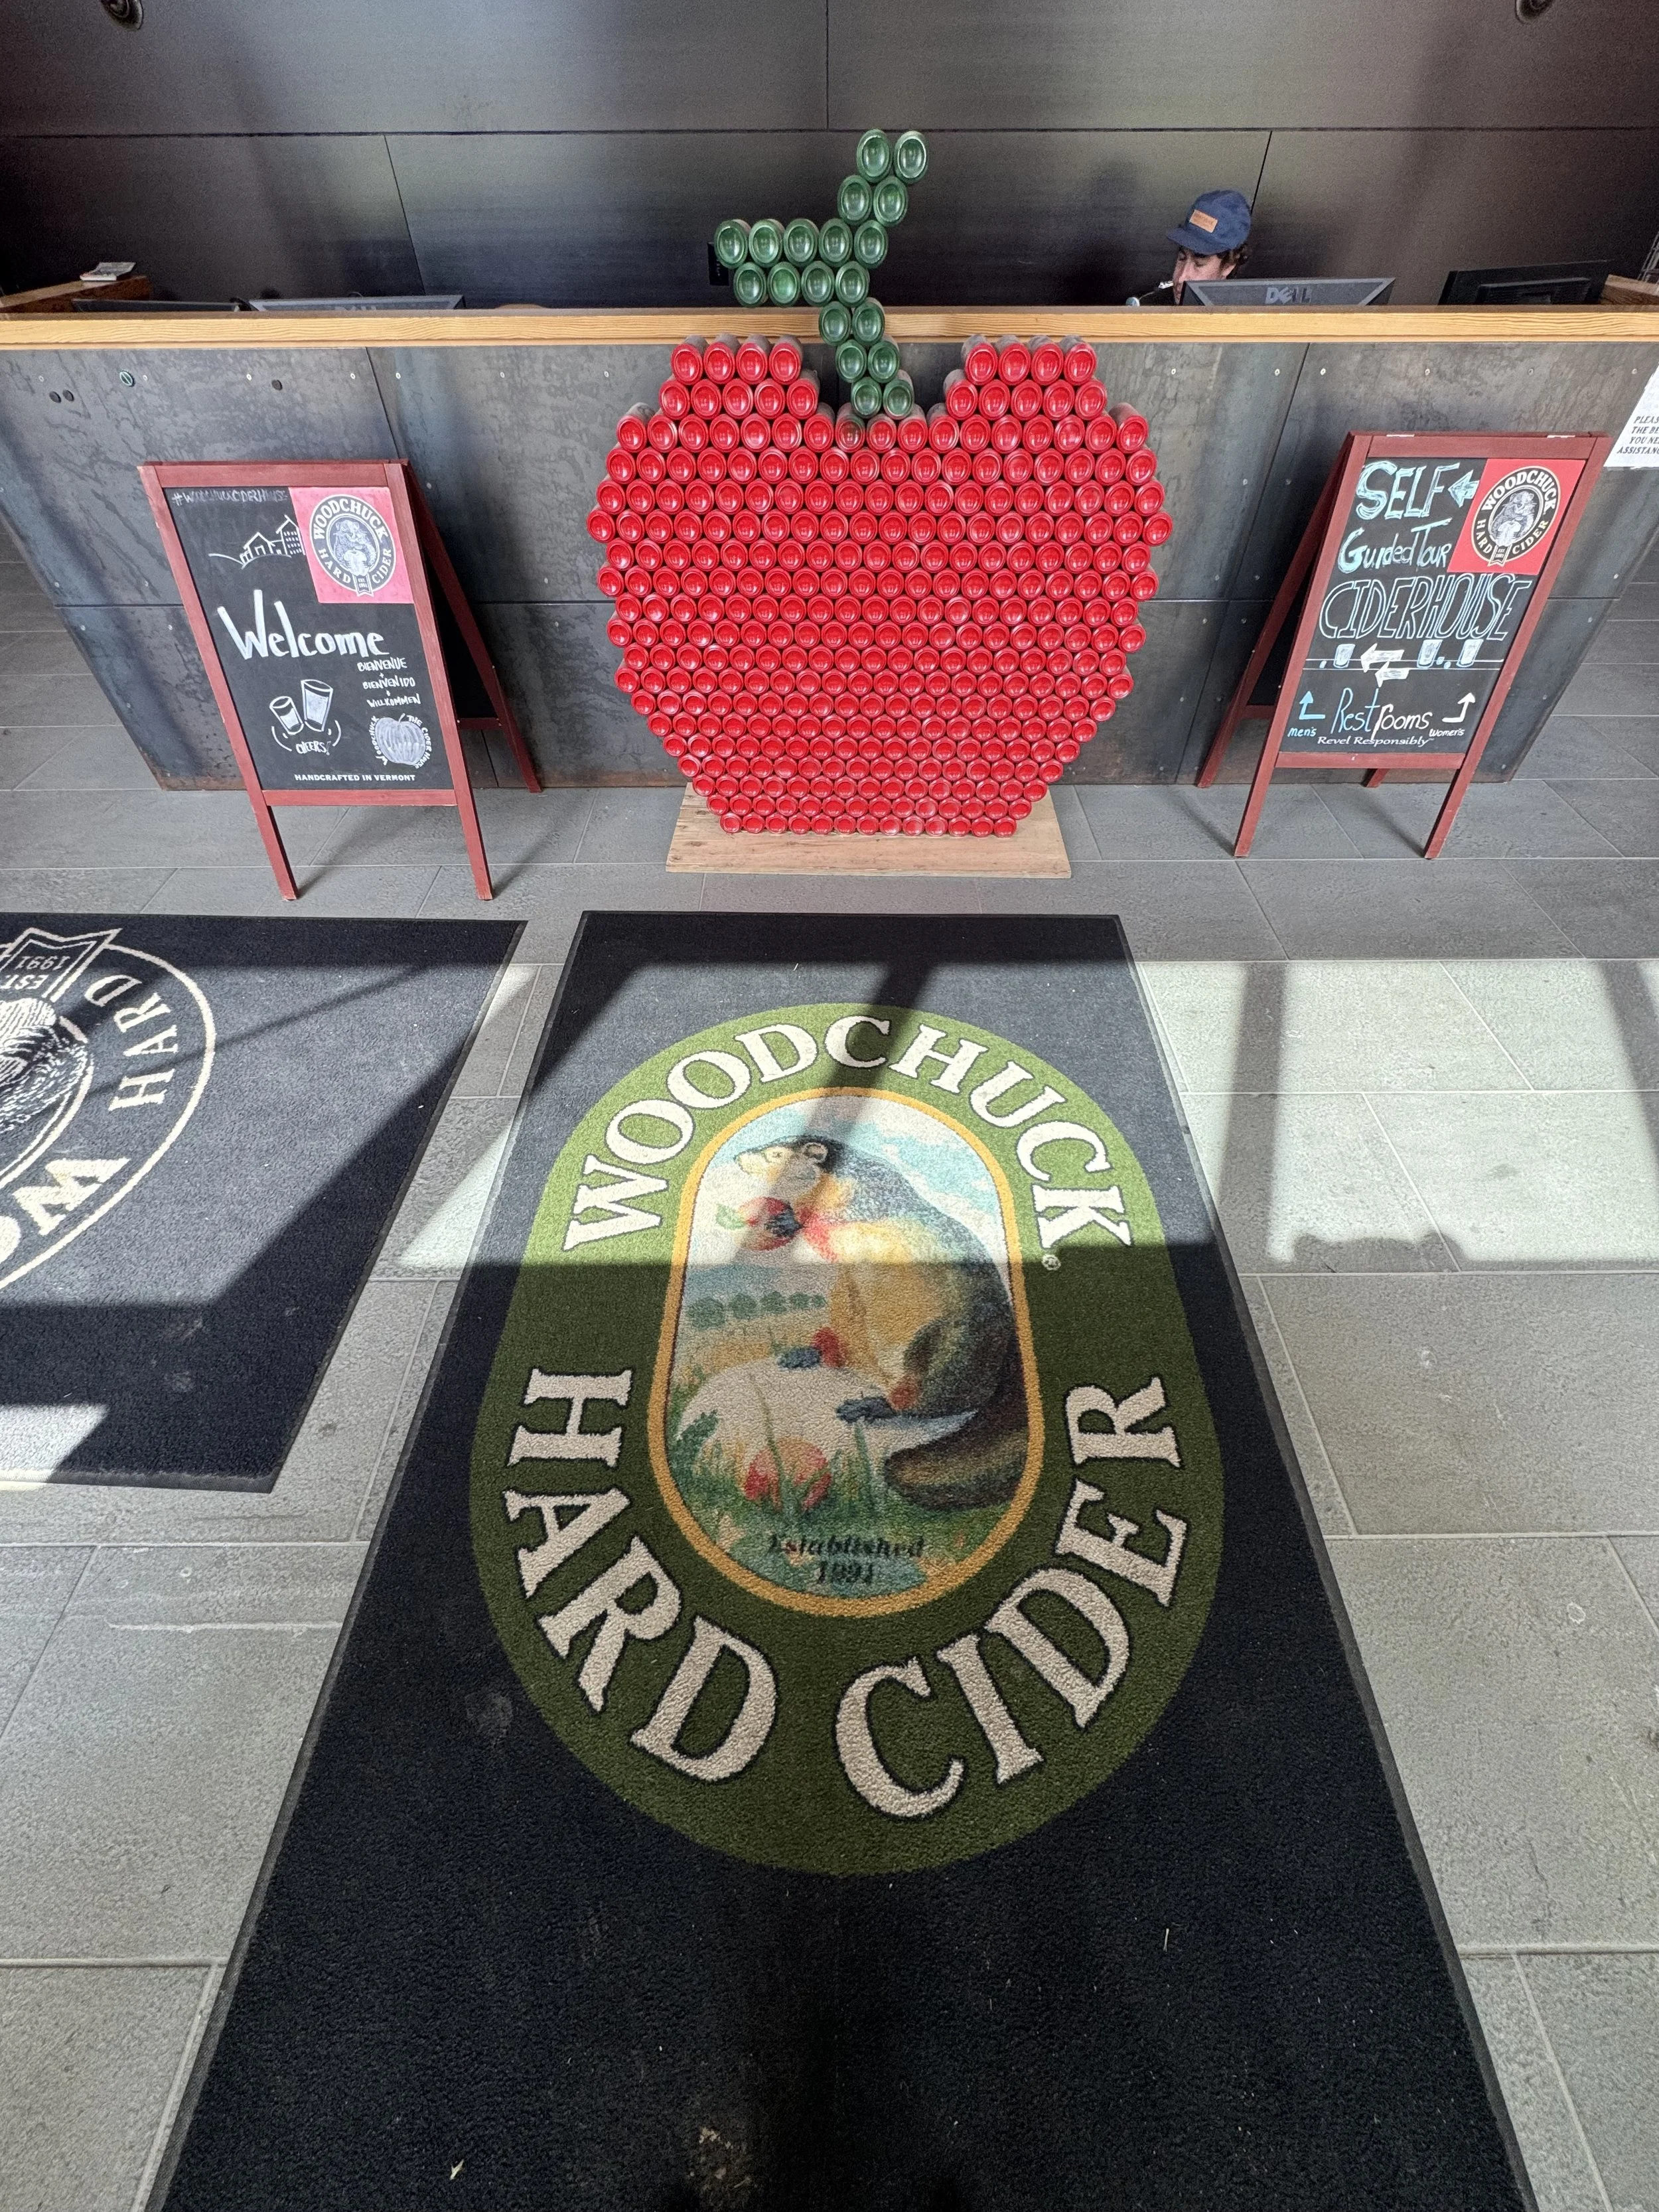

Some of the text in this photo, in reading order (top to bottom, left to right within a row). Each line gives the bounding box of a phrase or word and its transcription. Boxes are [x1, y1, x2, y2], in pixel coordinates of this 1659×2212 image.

[1265, 287, 1312, 304] DELL
[1355, 460, 1461, 520] SELF
[1481, 470, 1557, 512] WOODCHUCK
[313, 498, 389, 543] WOODCHUCK
[1477, 519, 1548, 555] HARD CIDER
[319, 548, 392, 584] HARD CIDER
[217, 589, 390, 660] Welcome
[1319, 573, 1532, 640] CIDERHOUSE
[357, 656, 407, 672] BIENVENUE
[362, 675, 415, 690] BIENVENIDO
[367, 693, 421, 707] WILLKOMMEN
[369, 715, 388, 766] WOODCHUCK
[406, 715, 423, 727] THE
[421, 727, 432, 752] CIDER
[1317, 736, 1429, 747] Revel Responsibly
[13, 955, 71, 971] 1991
[84, 974, 179, 1116] HARD
[563, 1015, 1132, 1250] WOODCHUCK
[502, 1367, 1190, 1818] HARD CIDER
